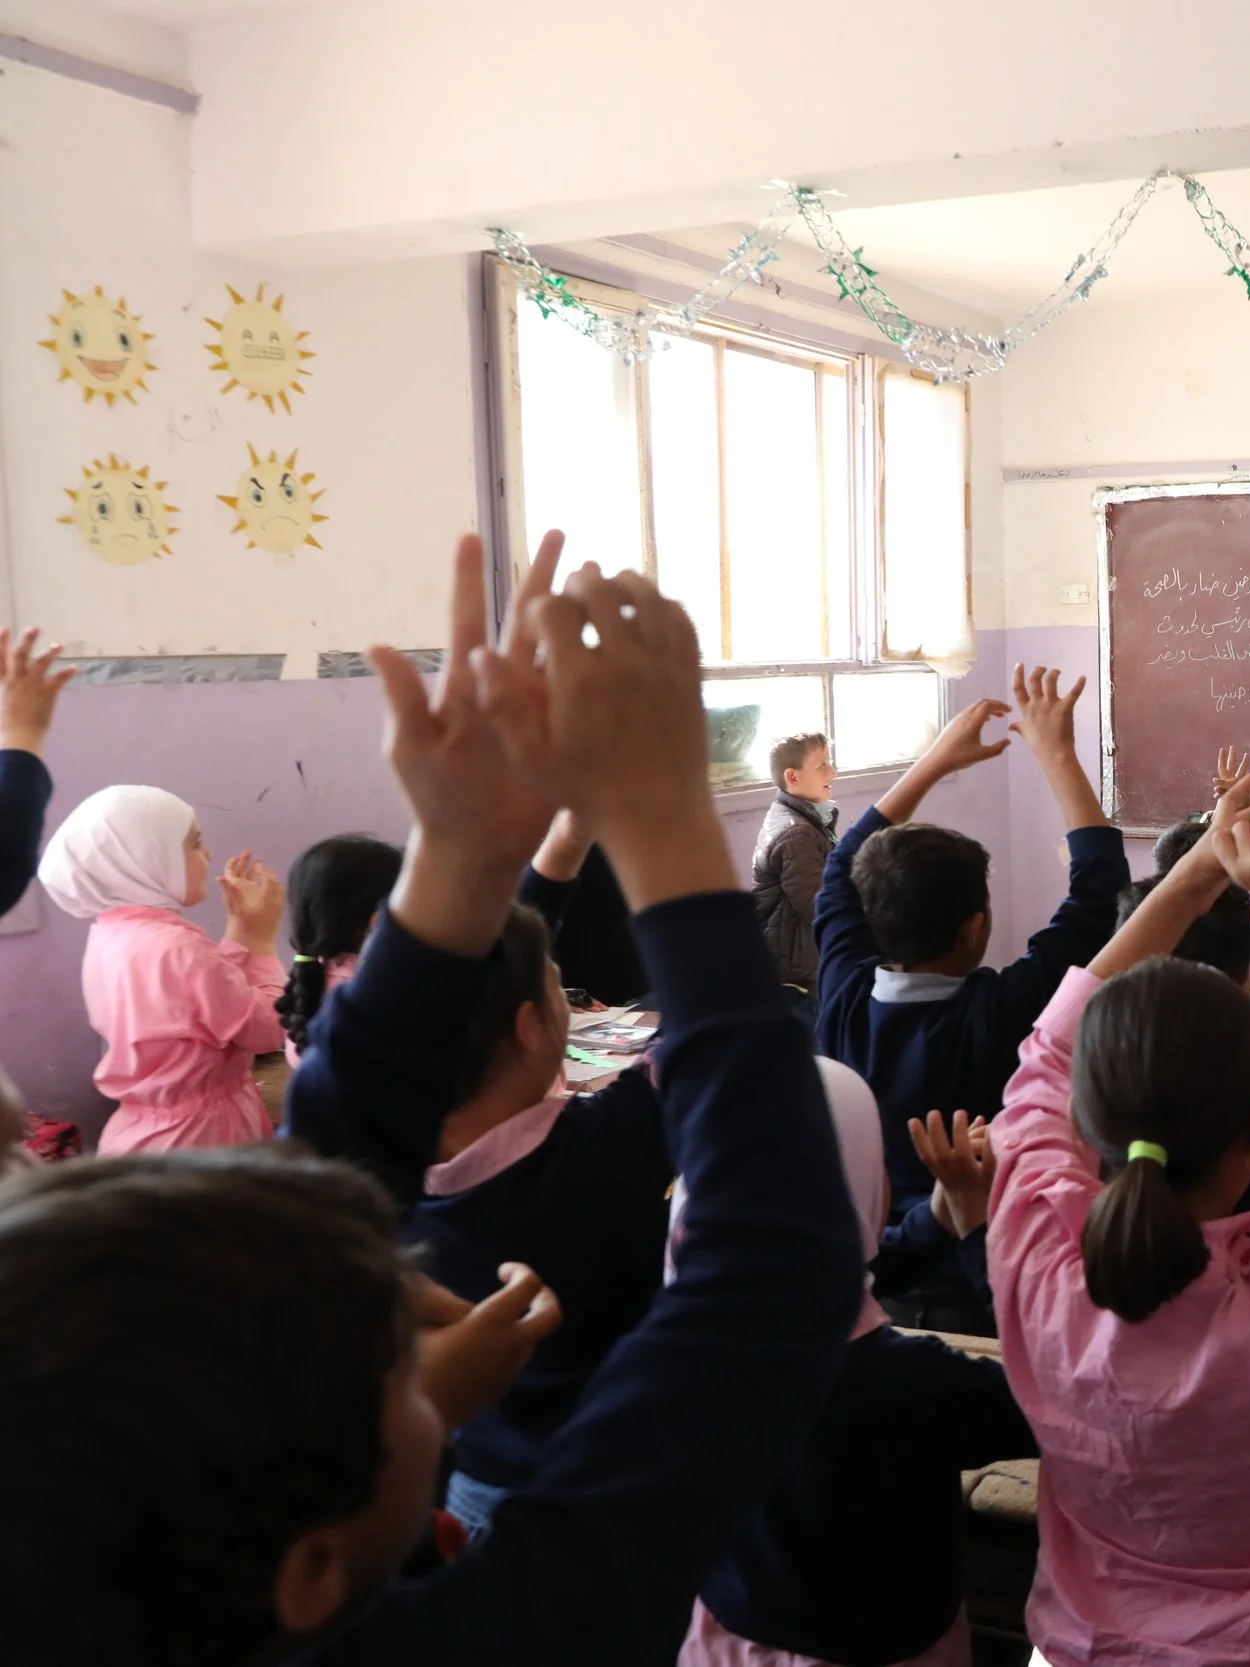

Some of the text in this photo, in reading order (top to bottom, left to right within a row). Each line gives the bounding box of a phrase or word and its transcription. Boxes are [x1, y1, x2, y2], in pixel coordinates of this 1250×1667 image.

[1143, 567, 1189, 602] بالصحة
[1190, 570, 1220, 596] ضار
[1157, 609, 1200, 636] لحدوث
[1201, 606, 1248, 639] رئيسي
[1188, 639, 1236, 667] القلب
